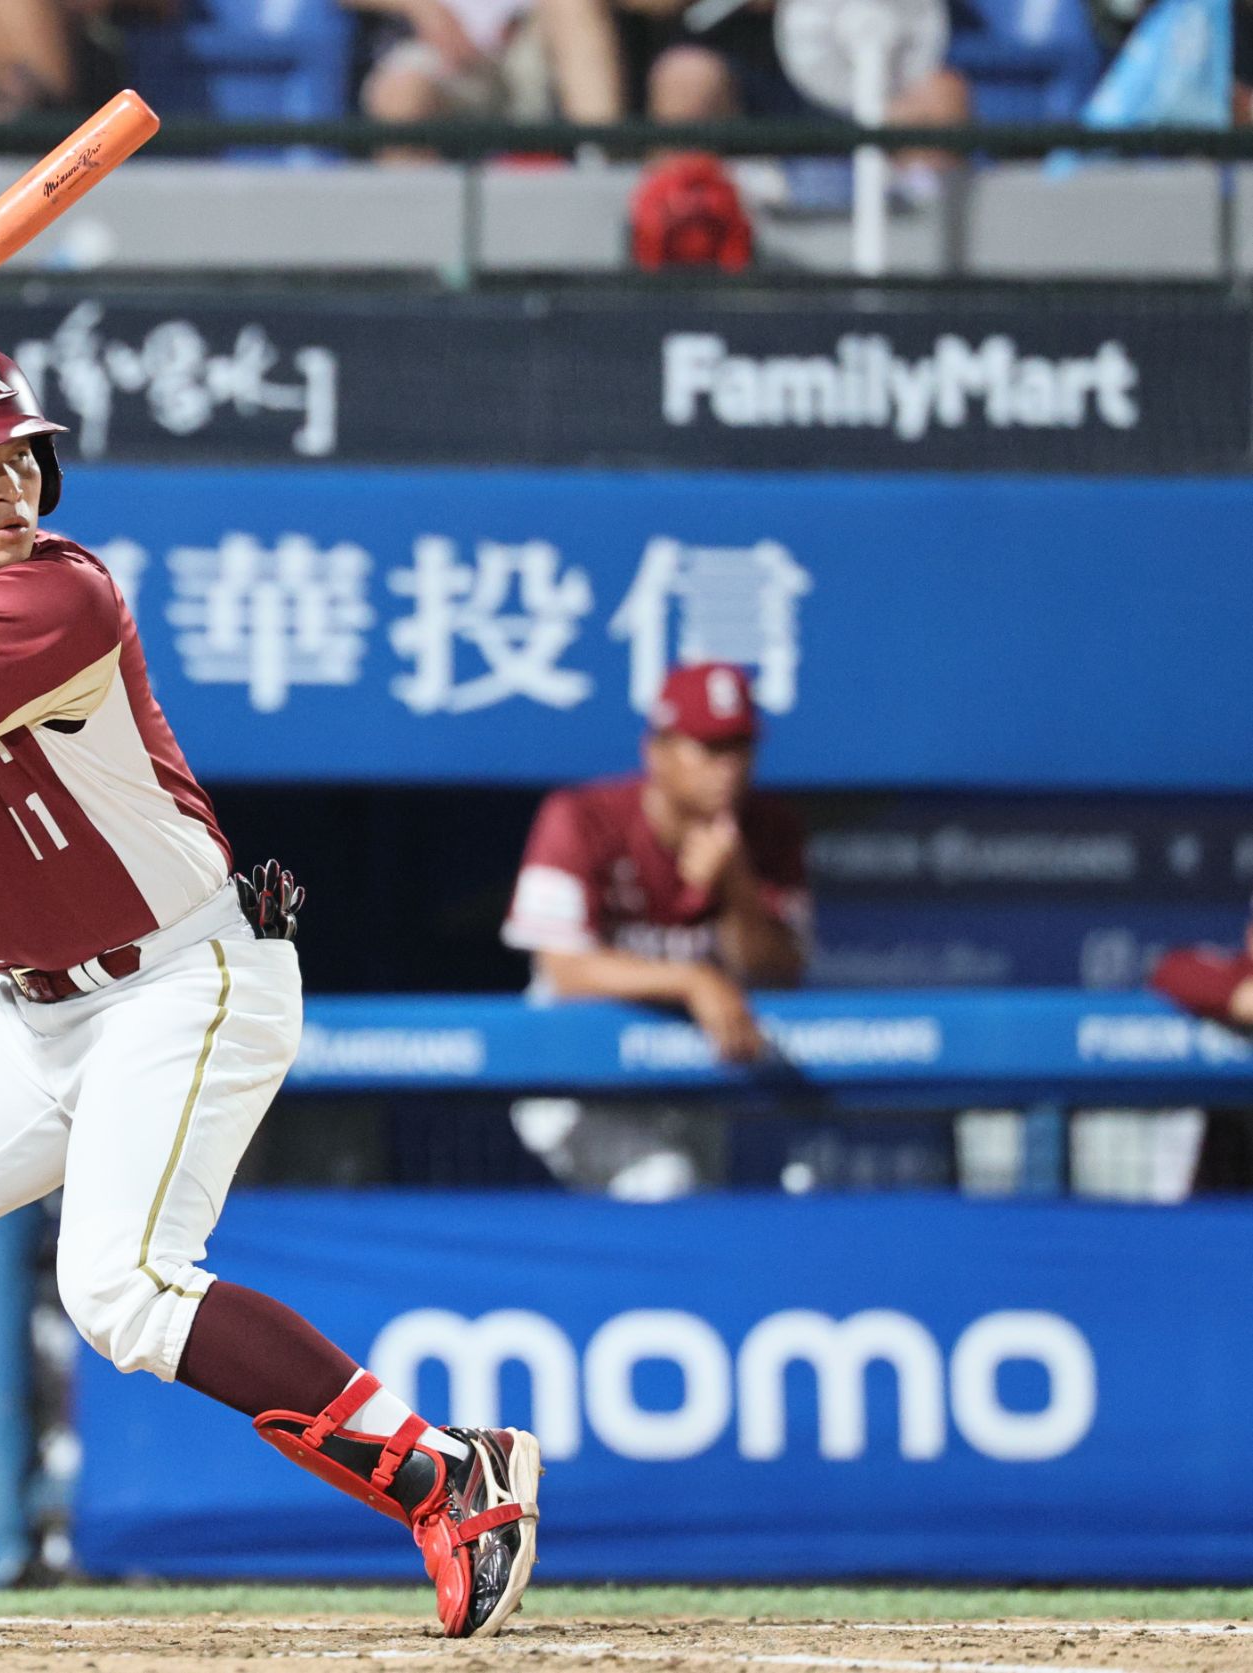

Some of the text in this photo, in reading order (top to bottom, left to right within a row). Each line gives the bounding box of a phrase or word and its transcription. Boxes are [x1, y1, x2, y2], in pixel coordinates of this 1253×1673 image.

[660, 332, 1139, 440] FamilyMart
[102, 533, 815, 716] 華投信
[367, 1307, 1098, 1462] momo
